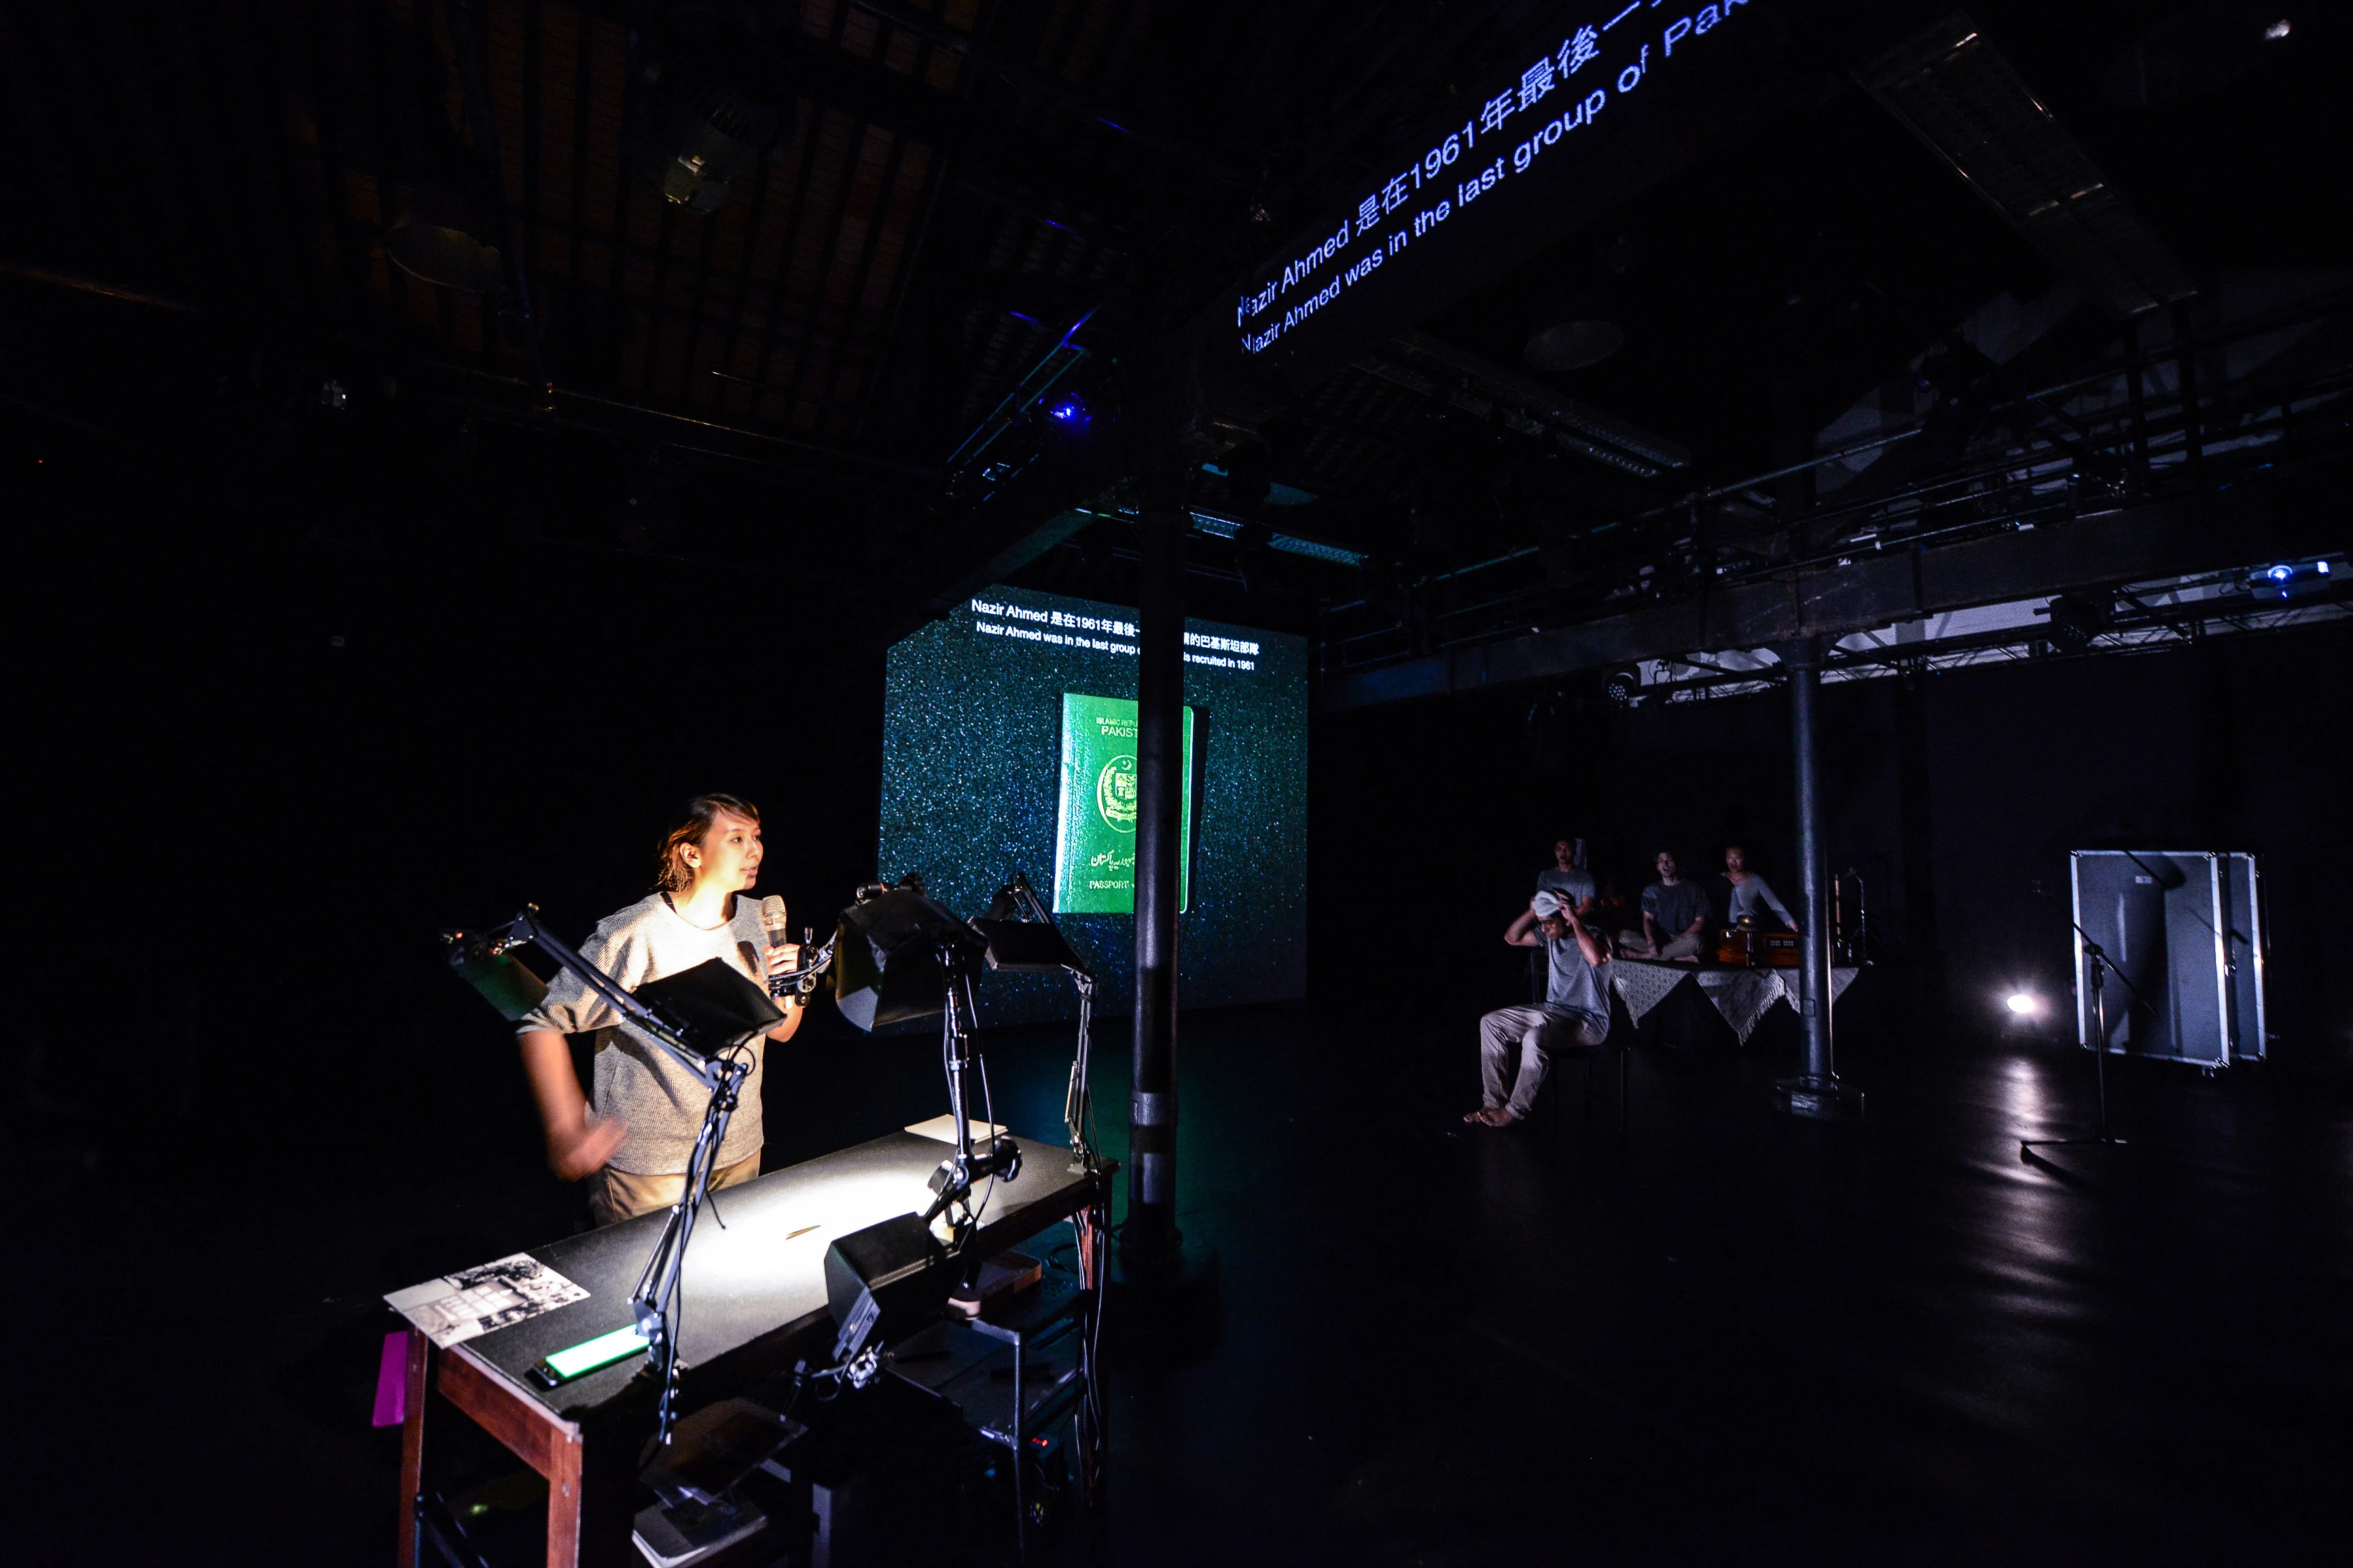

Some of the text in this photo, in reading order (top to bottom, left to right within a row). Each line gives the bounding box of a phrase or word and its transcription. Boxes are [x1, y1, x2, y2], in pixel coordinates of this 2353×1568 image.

[1238, 0, 1662, 328] Nazir Ahmed 是在1961年最後一
[1242, 322, 1281, 354] Nazir
[1284, 274, 1341, 332] Ahmed
[1345, 247, 1384, 286] was
[1388, 229, 1407, 255] in
[1414, 199, 1451, 237] the
[1458, 156, 1505, 206] last
[1513, 88, 1606, 173] group
[1617, 43, 1649, 92] of
[971, 598, 1005, 615] Nazir
[1005, 604, 1048, 623] Ahmed
[976, 621, 1005, 636] Nazir
[1005, 626, 1042, 641] Ahmed
[1043, 634, 1063, 644] was
[1064, 634, 1074, 646] in
[1075, 636, 1091, 649] the
[1092, 638, 1109, 651] last
[1110, 642, 1136, 656] group
[1192, 655, 1227, 667] recruited
[1227, 657, 1236, 668] in
[1096, 716, 1120, 726] ISLAMIC
[1101, 725, 1138, 738] PAKIST
[1089, 880, 1130, 890] PASSPORT
